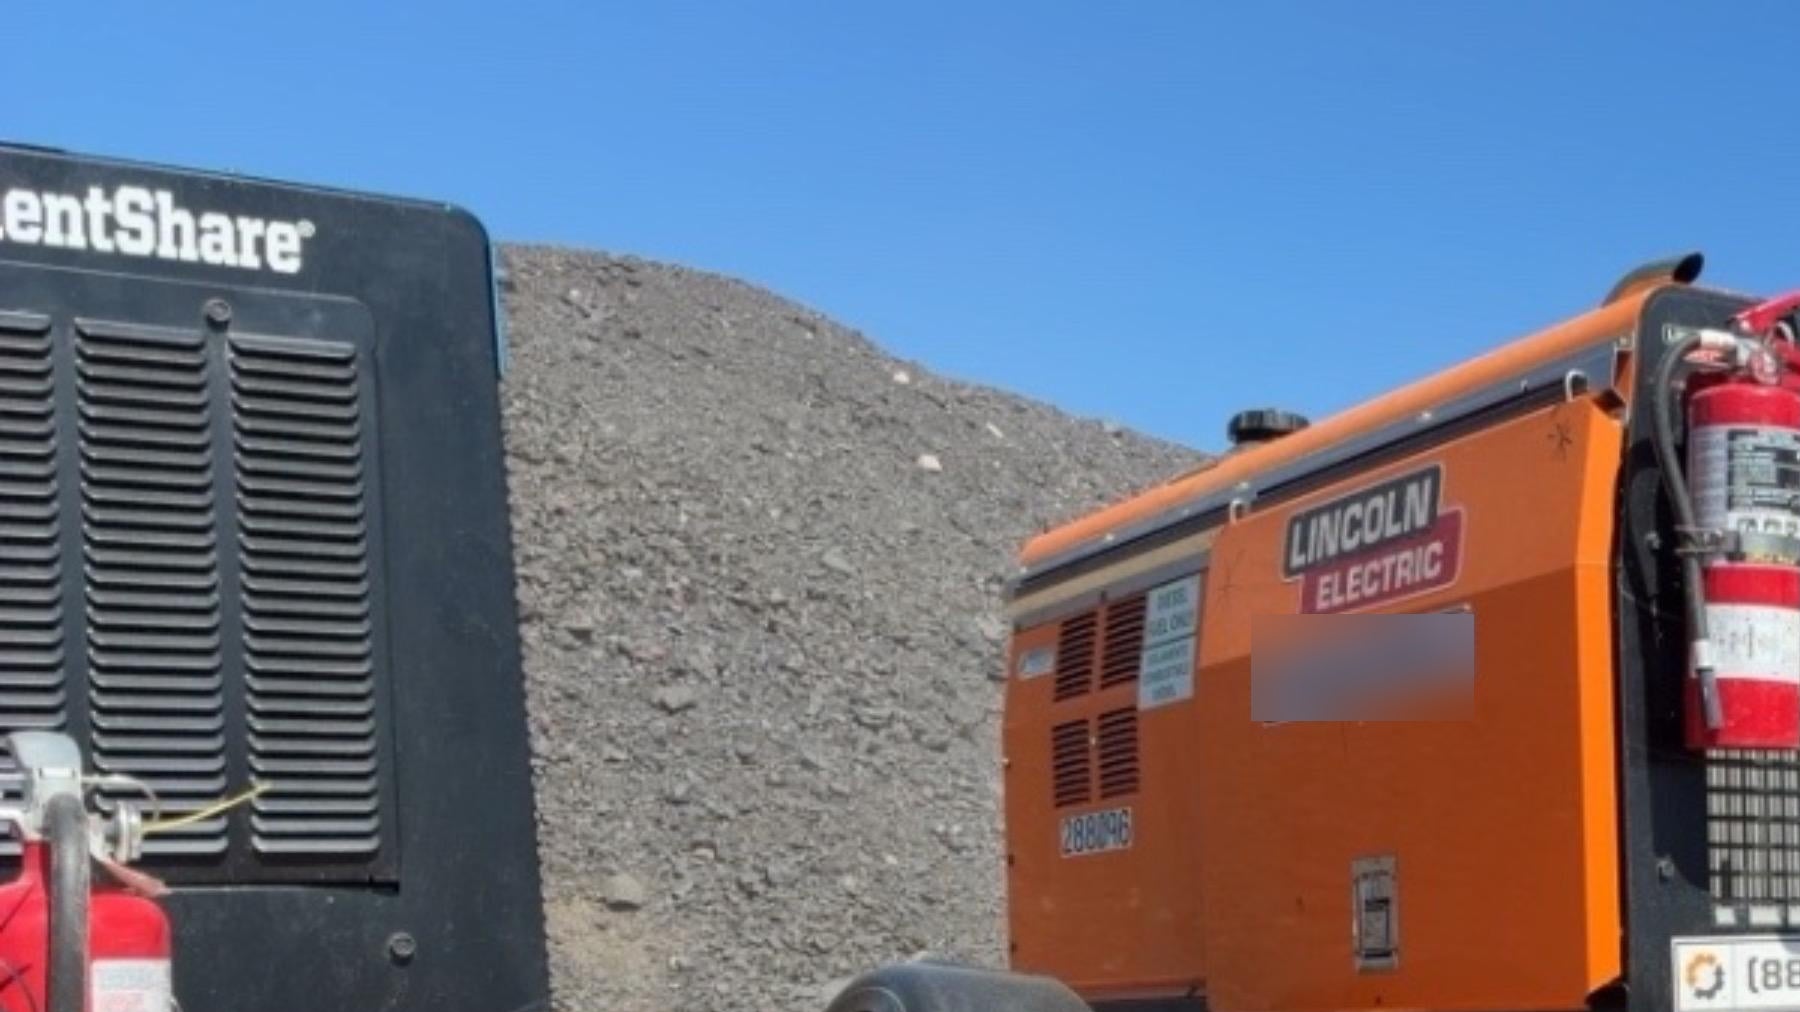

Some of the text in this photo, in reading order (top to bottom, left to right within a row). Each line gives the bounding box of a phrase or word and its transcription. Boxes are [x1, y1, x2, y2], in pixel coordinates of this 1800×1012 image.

[0, 185, 302, 273] entShare
[1289, 476, 1433, 569] LINCOLN
[1315, 540, 1444, 611] ELECTRIC
